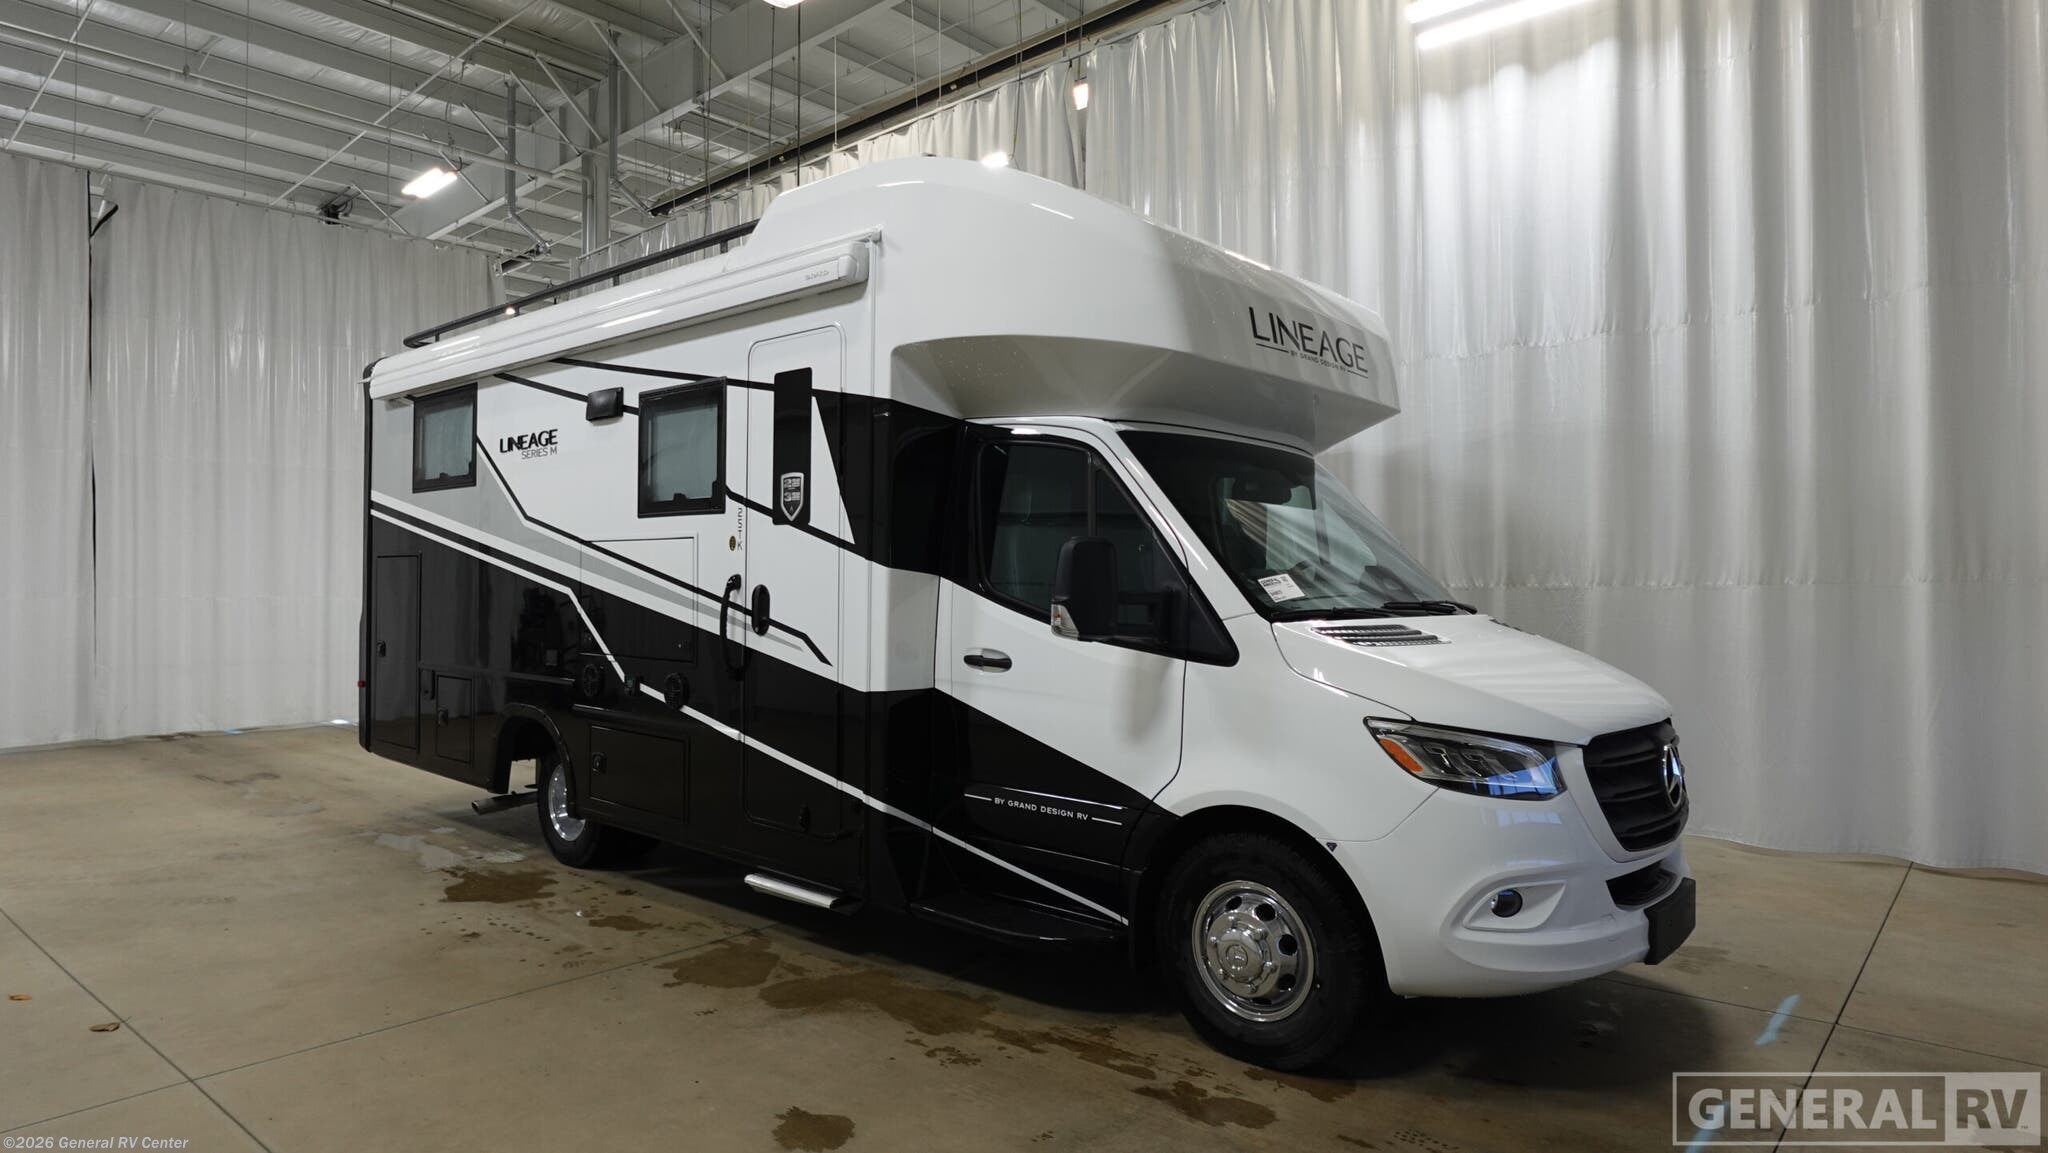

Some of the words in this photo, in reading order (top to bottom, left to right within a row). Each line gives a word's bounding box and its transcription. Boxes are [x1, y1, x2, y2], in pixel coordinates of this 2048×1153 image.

[1248, 306, 1369, 374] LINEAGE
[499, 428, 559, 454] LINEAGE
[521, 447, 549, 460] SERIES
[550, 446, 558, 456] M
[994, 797, 1006, 806] BY
[1007, 799, 1038, 812] GRAND
[1040, 805, 1074, 819] DESIGN
[1076, 812, 1089, 821] RV
